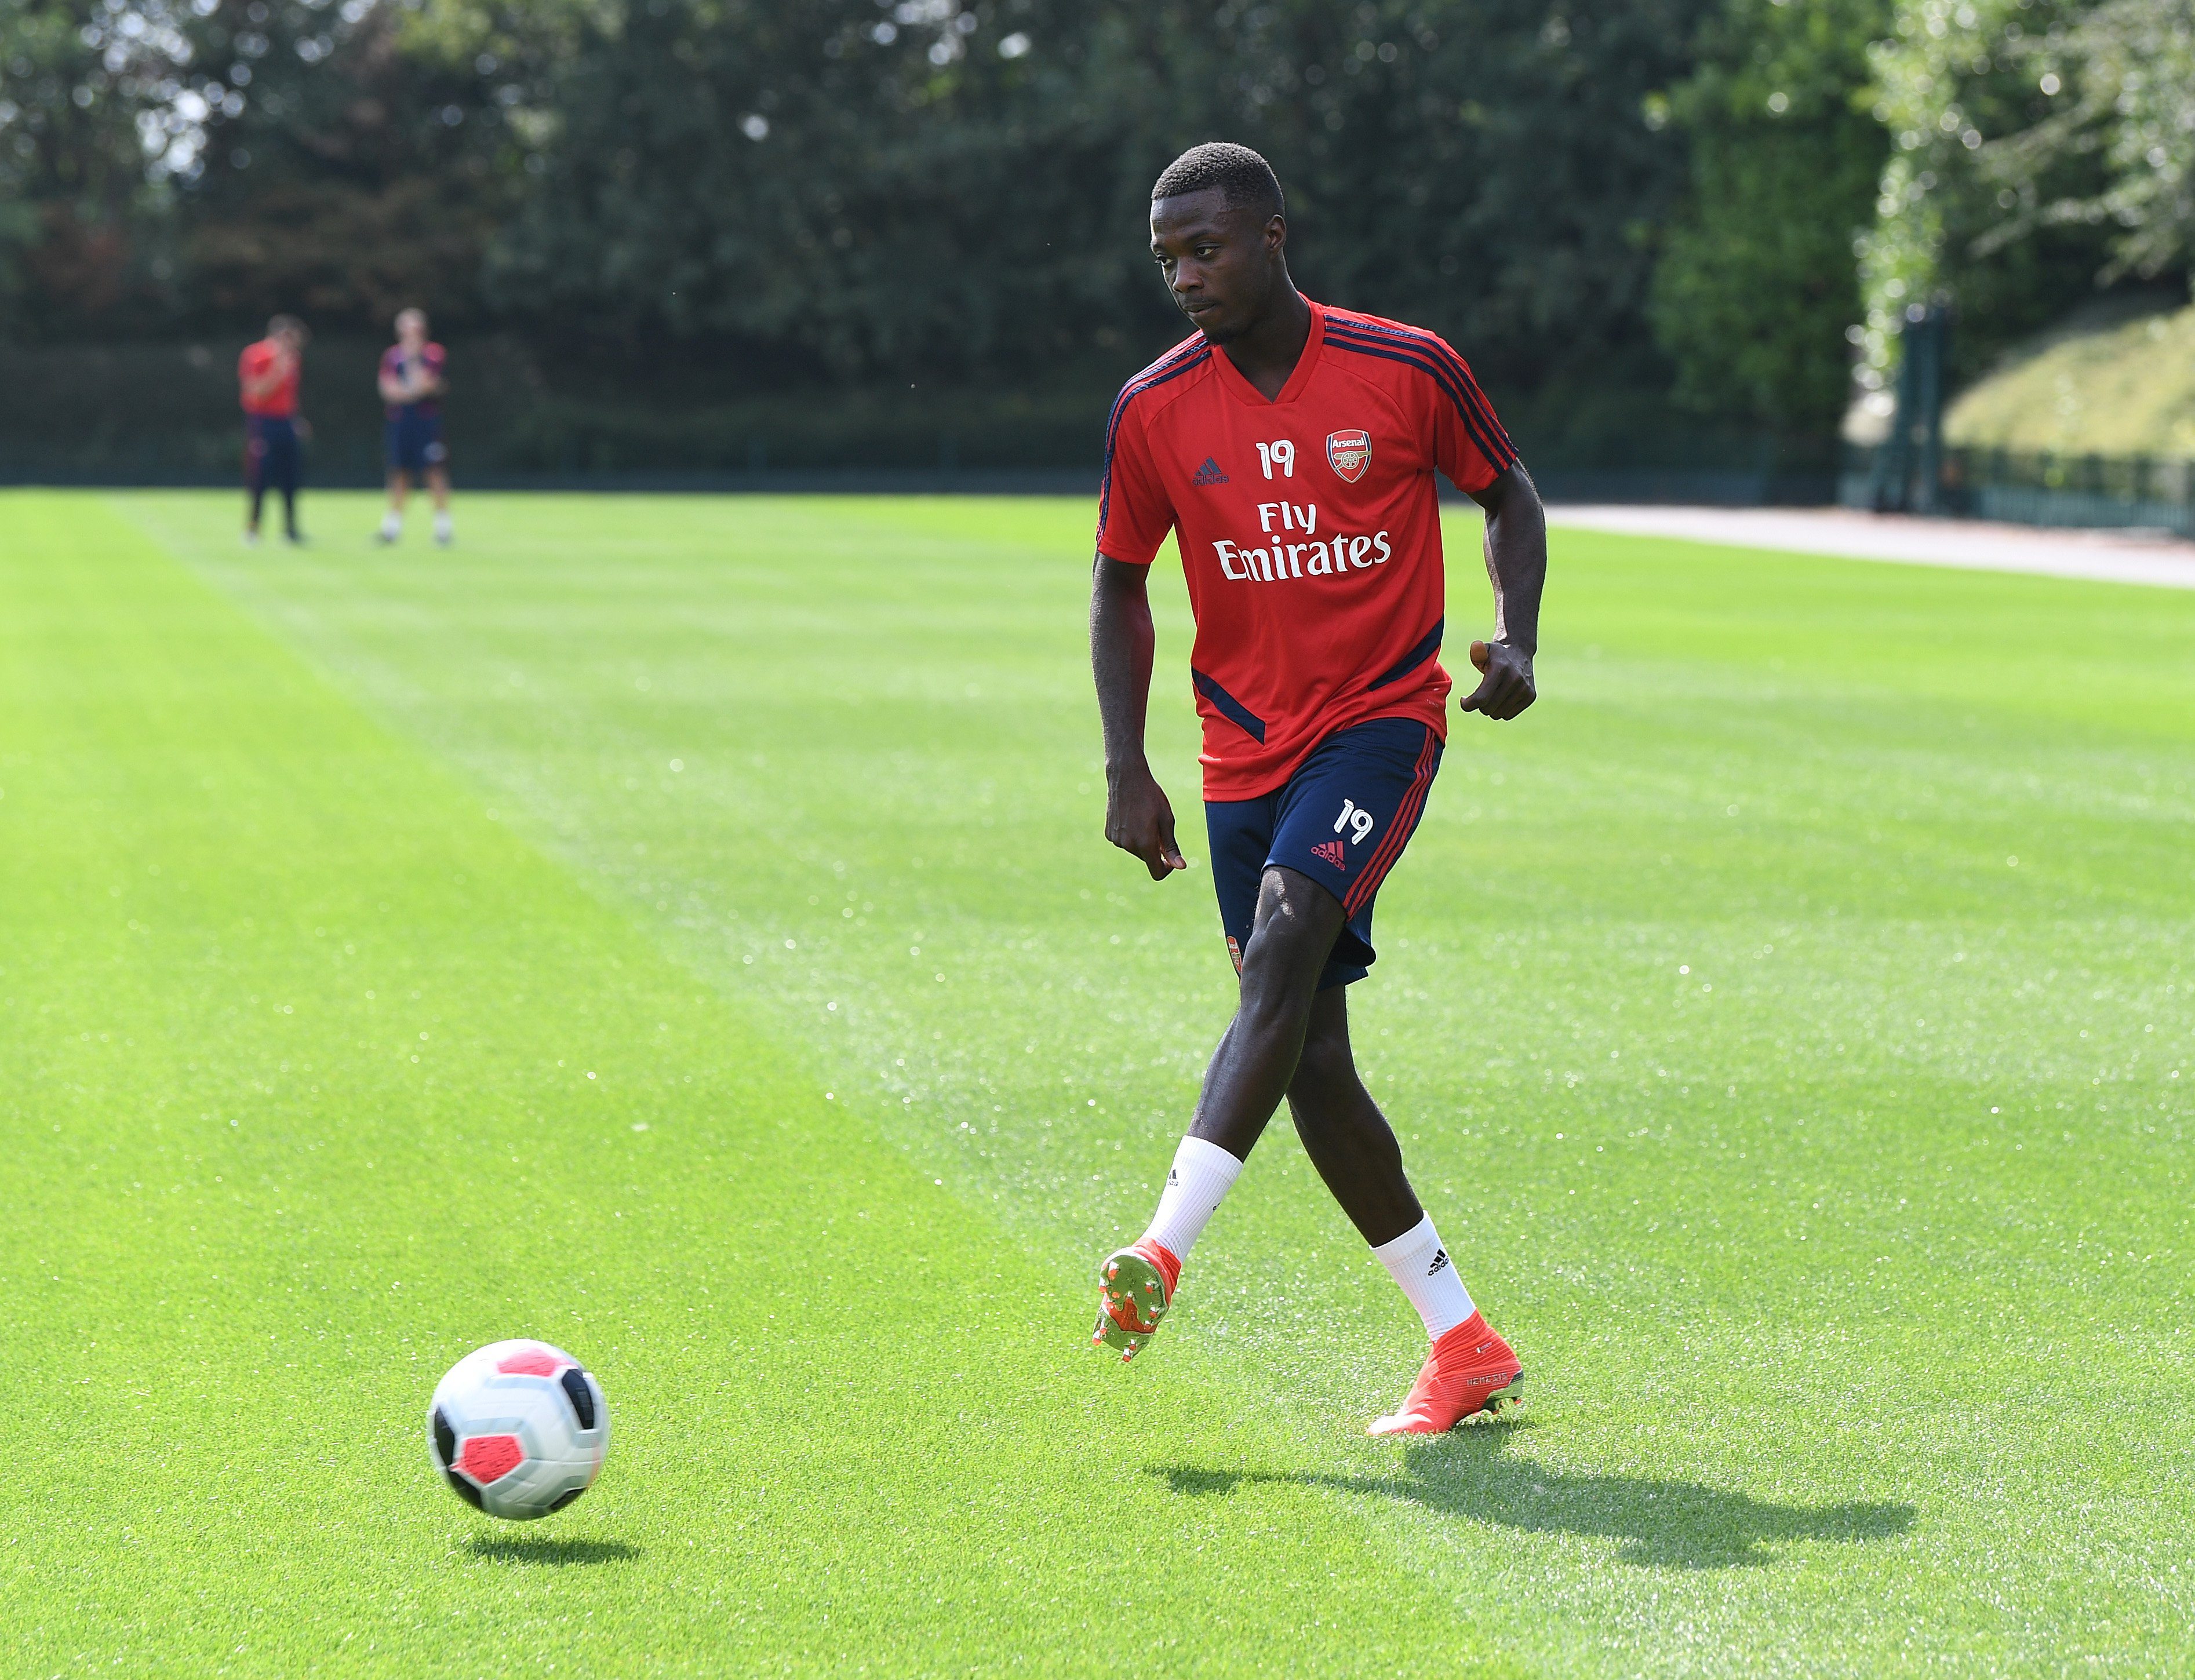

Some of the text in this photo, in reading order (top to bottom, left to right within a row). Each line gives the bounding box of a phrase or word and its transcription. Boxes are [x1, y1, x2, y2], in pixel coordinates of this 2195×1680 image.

[1332, 437, 1365, 449] Arsenal
[1255, 439, 1295, 480] 19
[1192, 474, 1229, 486] adidas
[1257, 501, 1316, 535] Fly
[1211, 530, 1392, 582] Emirates
[1333, 798, 1374, 846] 19
[1311, 846, 1346, 872] adidas
[1466, 1372, 1508, 1386] NEMESIS
